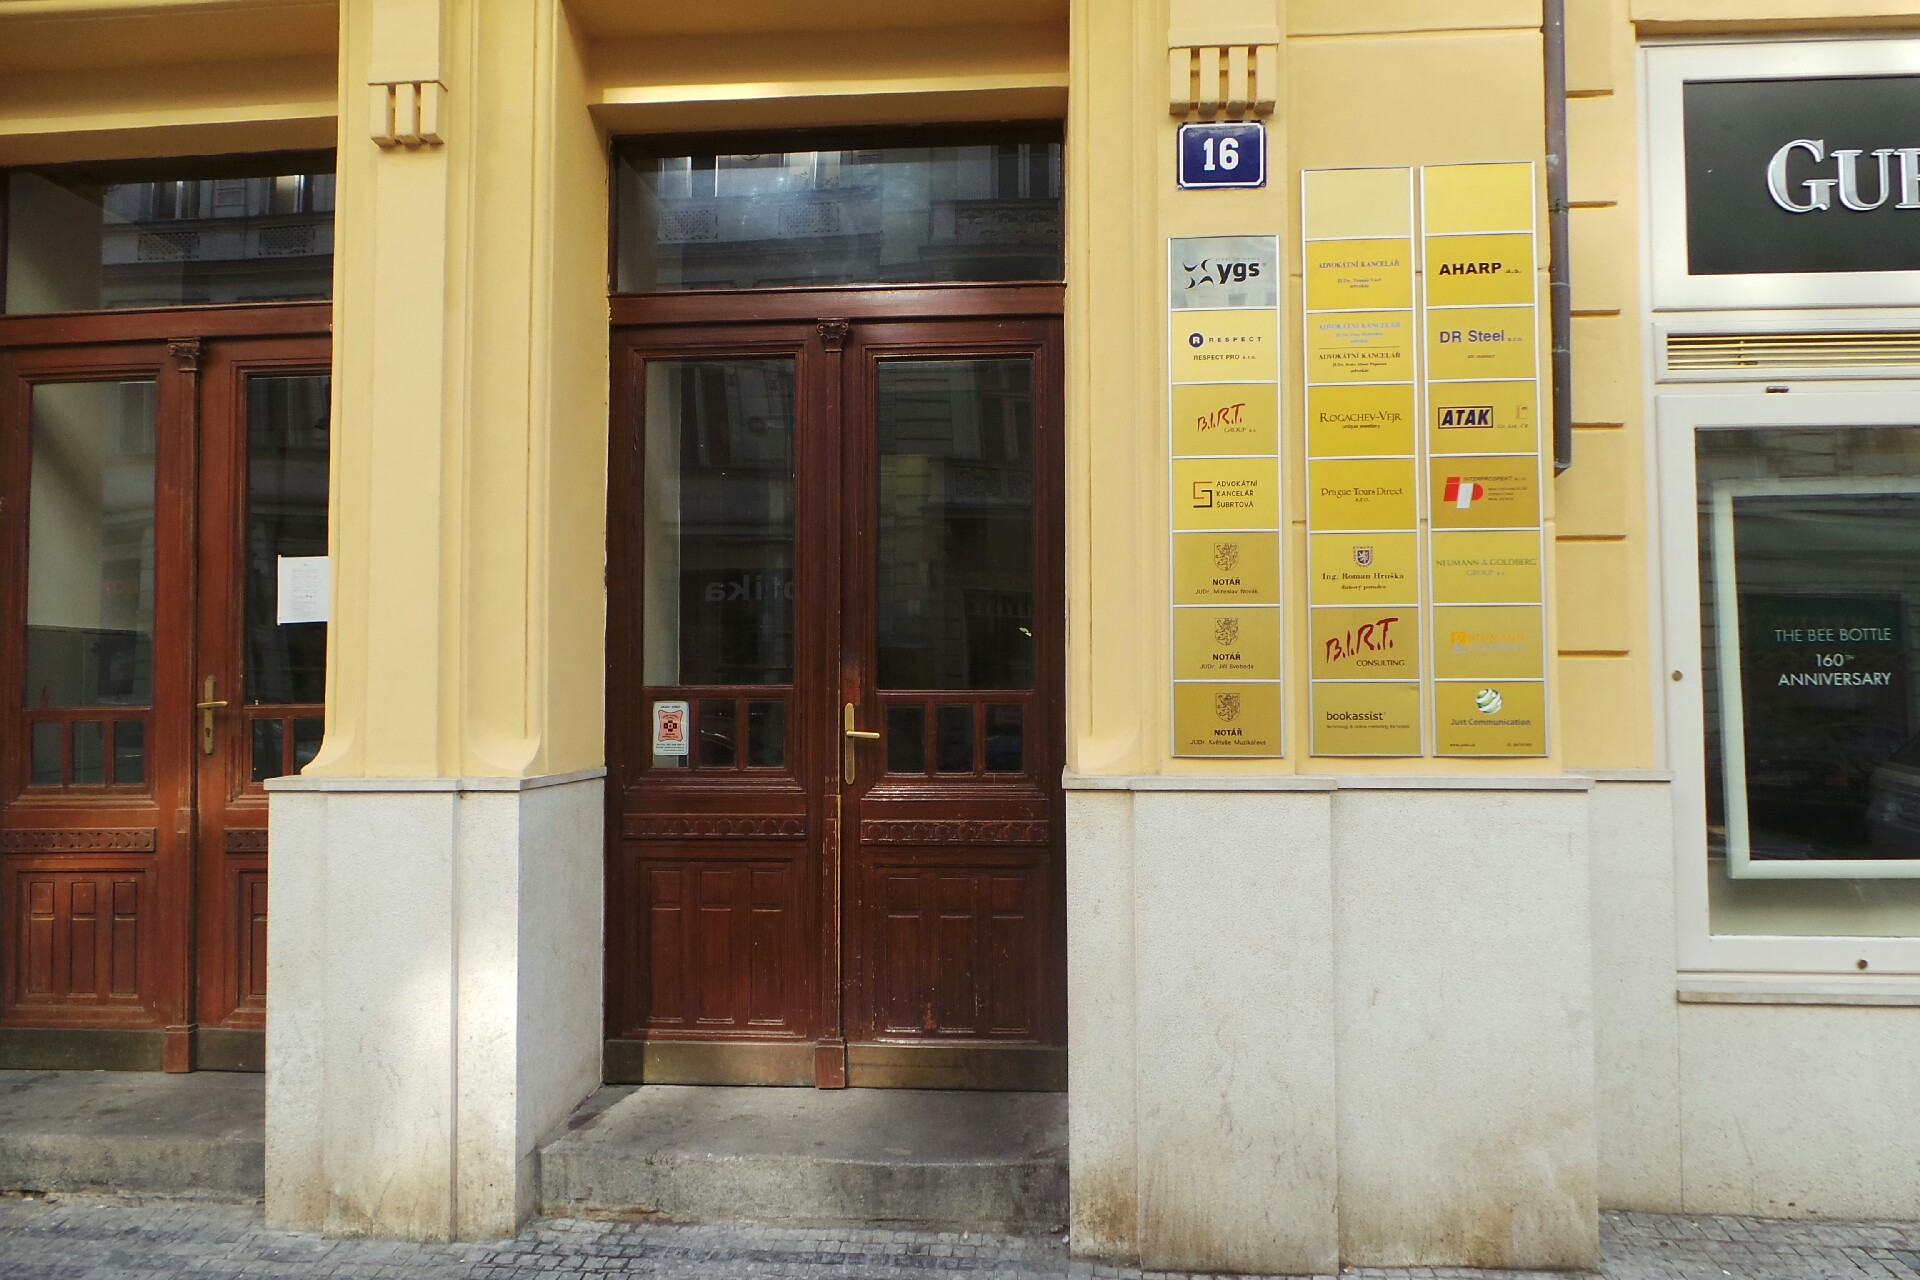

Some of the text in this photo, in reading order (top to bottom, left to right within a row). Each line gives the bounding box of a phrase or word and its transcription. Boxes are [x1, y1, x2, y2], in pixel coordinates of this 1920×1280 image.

[1203, 138, 1239, 171] 16
[1216, 262, 1260, 285] ygs
[1439, 262, 1502, 275] AHARP
[1439, 331, 1462, 343] DR
[1468, 330, 1504, 342] Steel
[1197, 403, 1246, 432] B.I.R.T.
[1319, 411, 1402, 423] ROGACHEV-VEJR
[1441, 409, 1490, 426] ATAK
[1216, 489, 1254, 497] KANCELÁŘ
[1321, 487, 1404, 498] Prague Tours Direct
[1216, 500, 1254, 508] ŠUBRTOVÁ
[1490, 558, 1537, 566] GOLDBERG
[1212, 577, 1241, 586] NOTÁŘ
[1322, 572, 1339, 581] Ing.
[1342, 572, 1371, 580] Roman
[1326, 617, 1399, 664] B.I.R.T.
[1774, 628, 1892, 642] THE BEE BOTTLE
[1212, 651, 1241, 661] NOTÁŘ
[1356, 659, 1405, 667] CONSULTING
[1778, 672, 1892, 686] ANNIVERSARY
[1326, 711, 1384, 721] bookassist
[1468, 718, 1531, 726] Communication
[1213, 728, 1243, 736] NOTÁŘ
